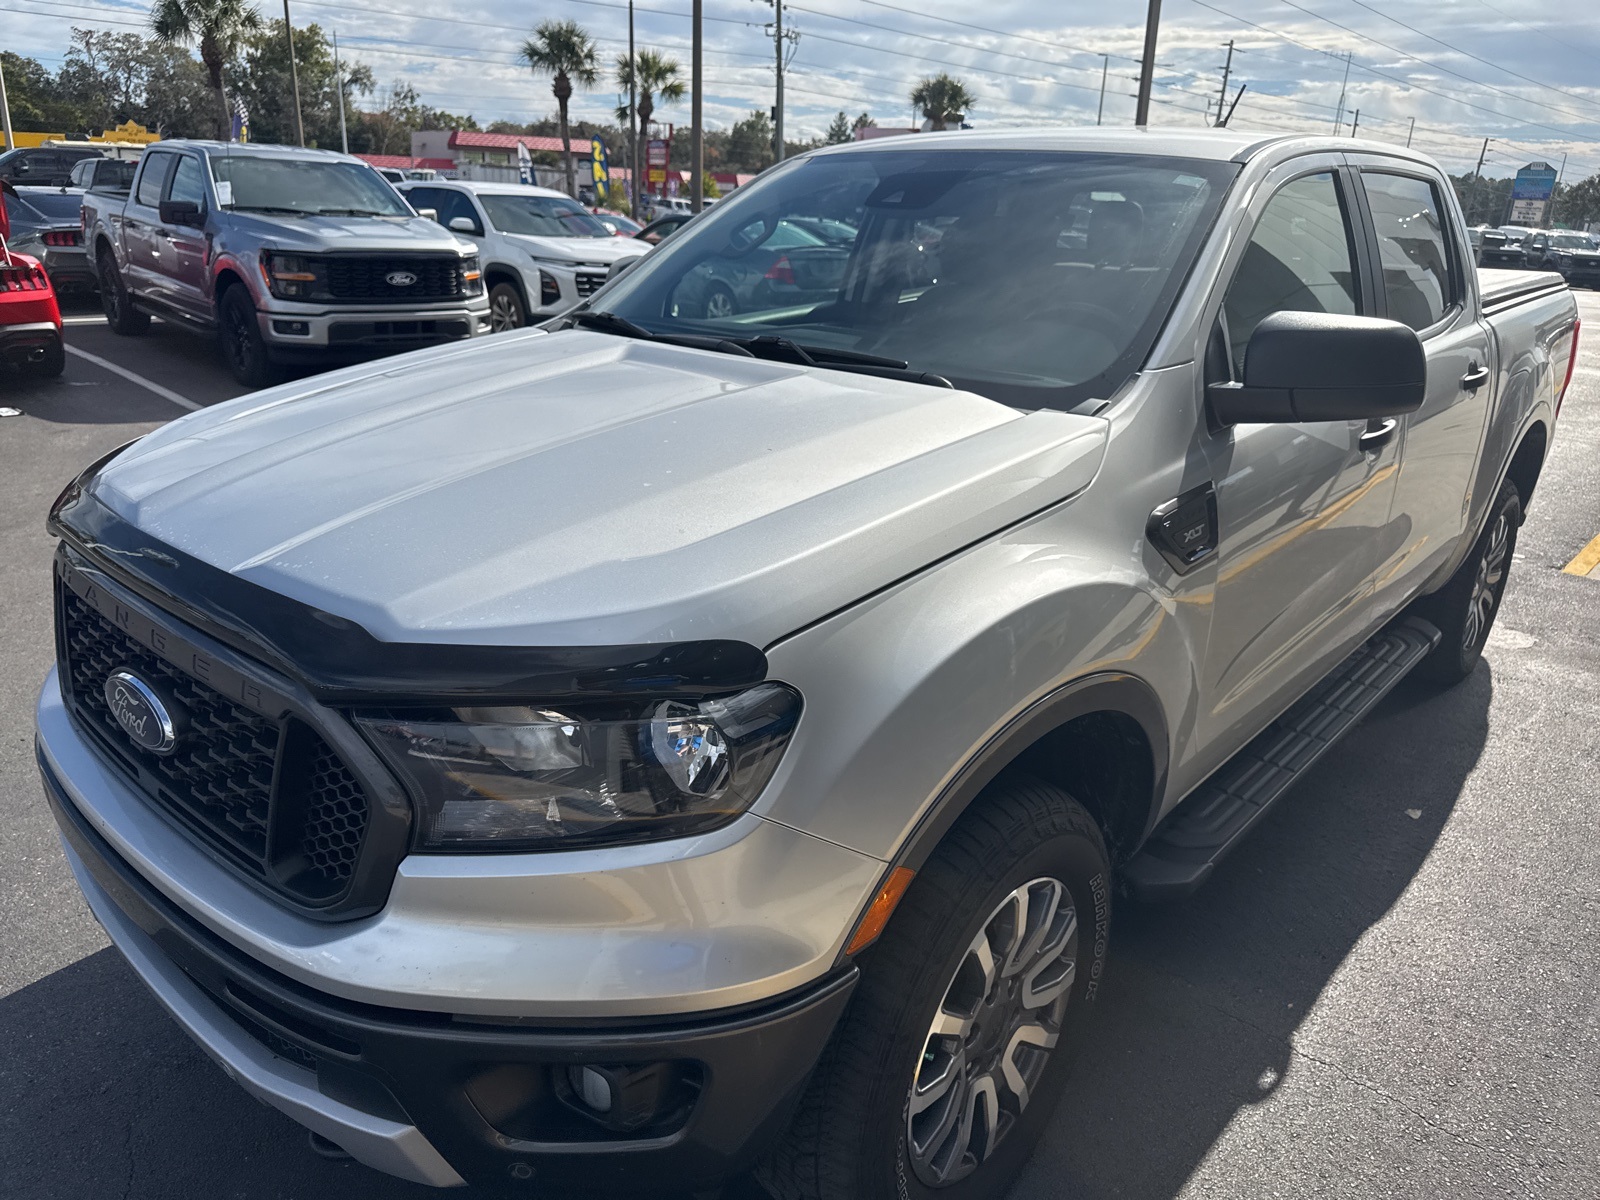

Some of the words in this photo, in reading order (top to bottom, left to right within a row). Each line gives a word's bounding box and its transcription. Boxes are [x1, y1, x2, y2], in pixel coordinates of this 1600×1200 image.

[1183, 523, 1205, 543] XLT
[62, 562, 264, 709] RANGER
[111, 684, 148, 738] Ford
